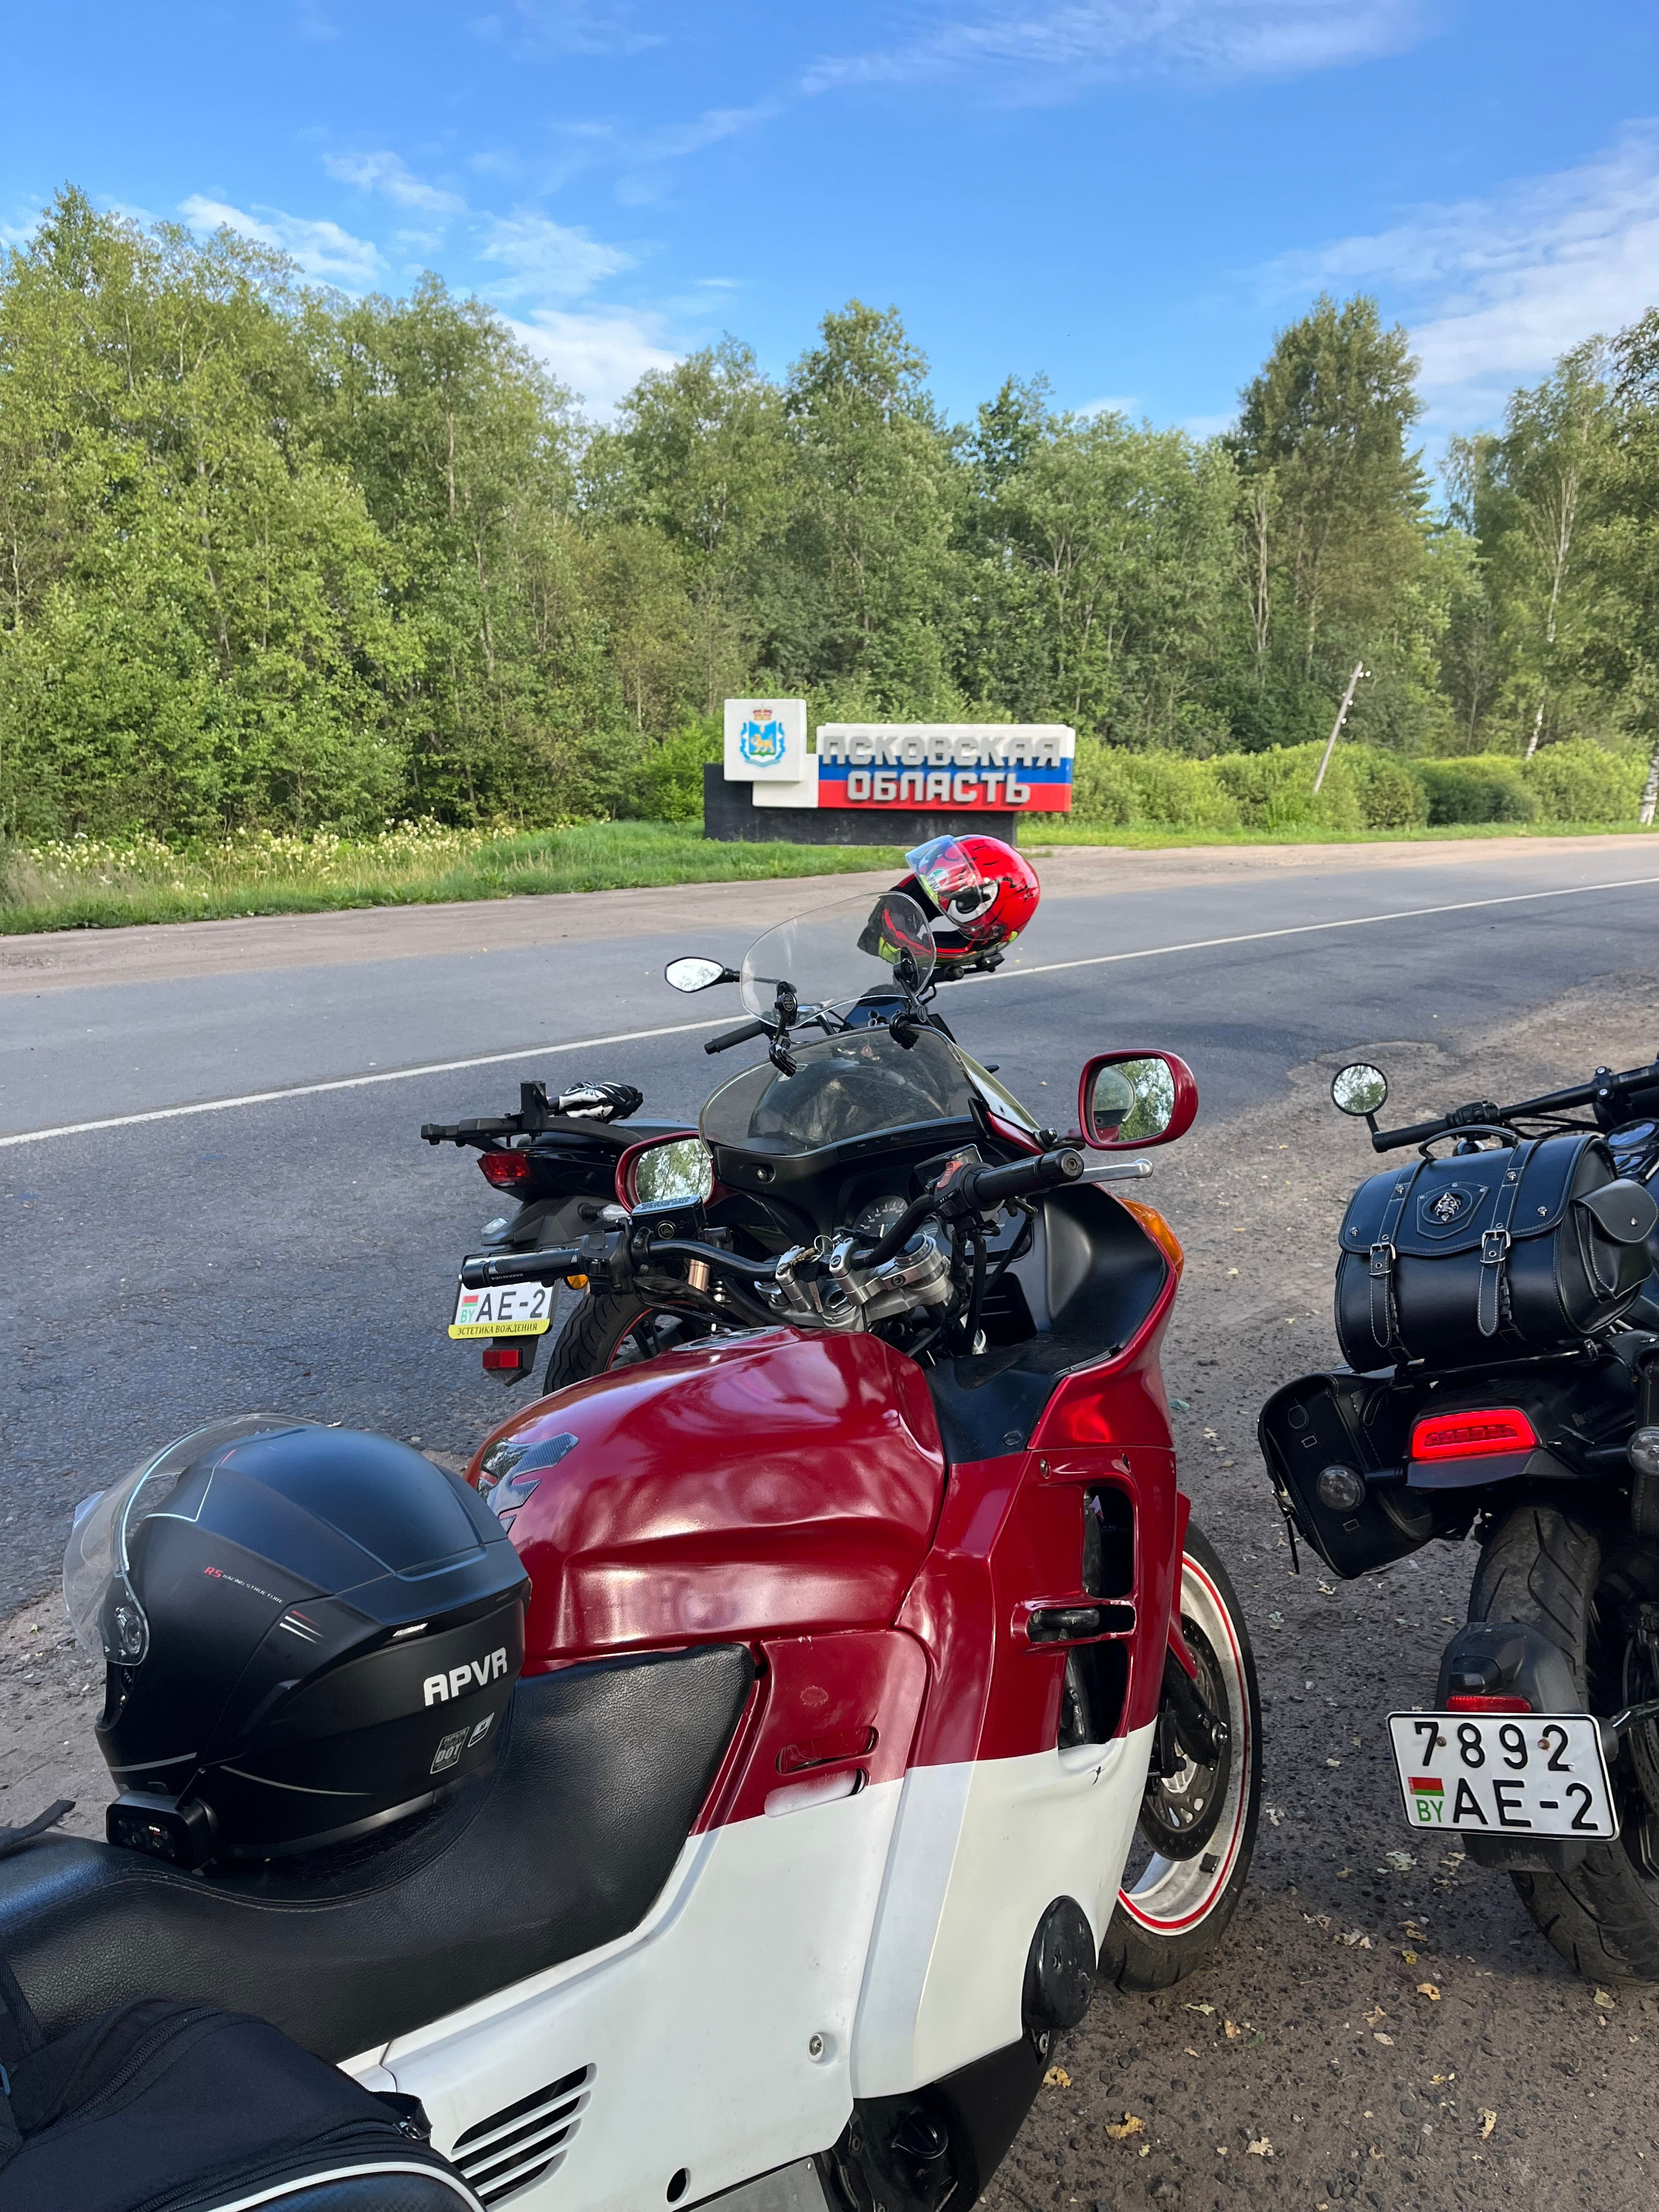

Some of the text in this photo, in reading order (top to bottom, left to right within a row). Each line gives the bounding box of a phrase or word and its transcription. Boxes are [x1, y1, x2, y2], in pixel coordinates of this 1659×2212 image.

[822, 736, 1061, 767] ПСКОВСКАЯ
[847, 771, 1030, 804] ОБЛАСТЬ
[460, 1309, 476, 1323] BY
[476, 1289, 546, 1321] AE-2
[458, 1323, 538, 1336] ЭСТЕТИКА ВОЖДЕНИЯ
[204, 1566, 224, 1578] RS
[423, 1647, 507, 1706] APVR
[435, 1742, 462, 1764] DOT
[1414, 1721, 1574, 1771] 7892
[1416, 1799, 1443, 1822] BY
[1453, 1778, 1599, 1830] AE-2
